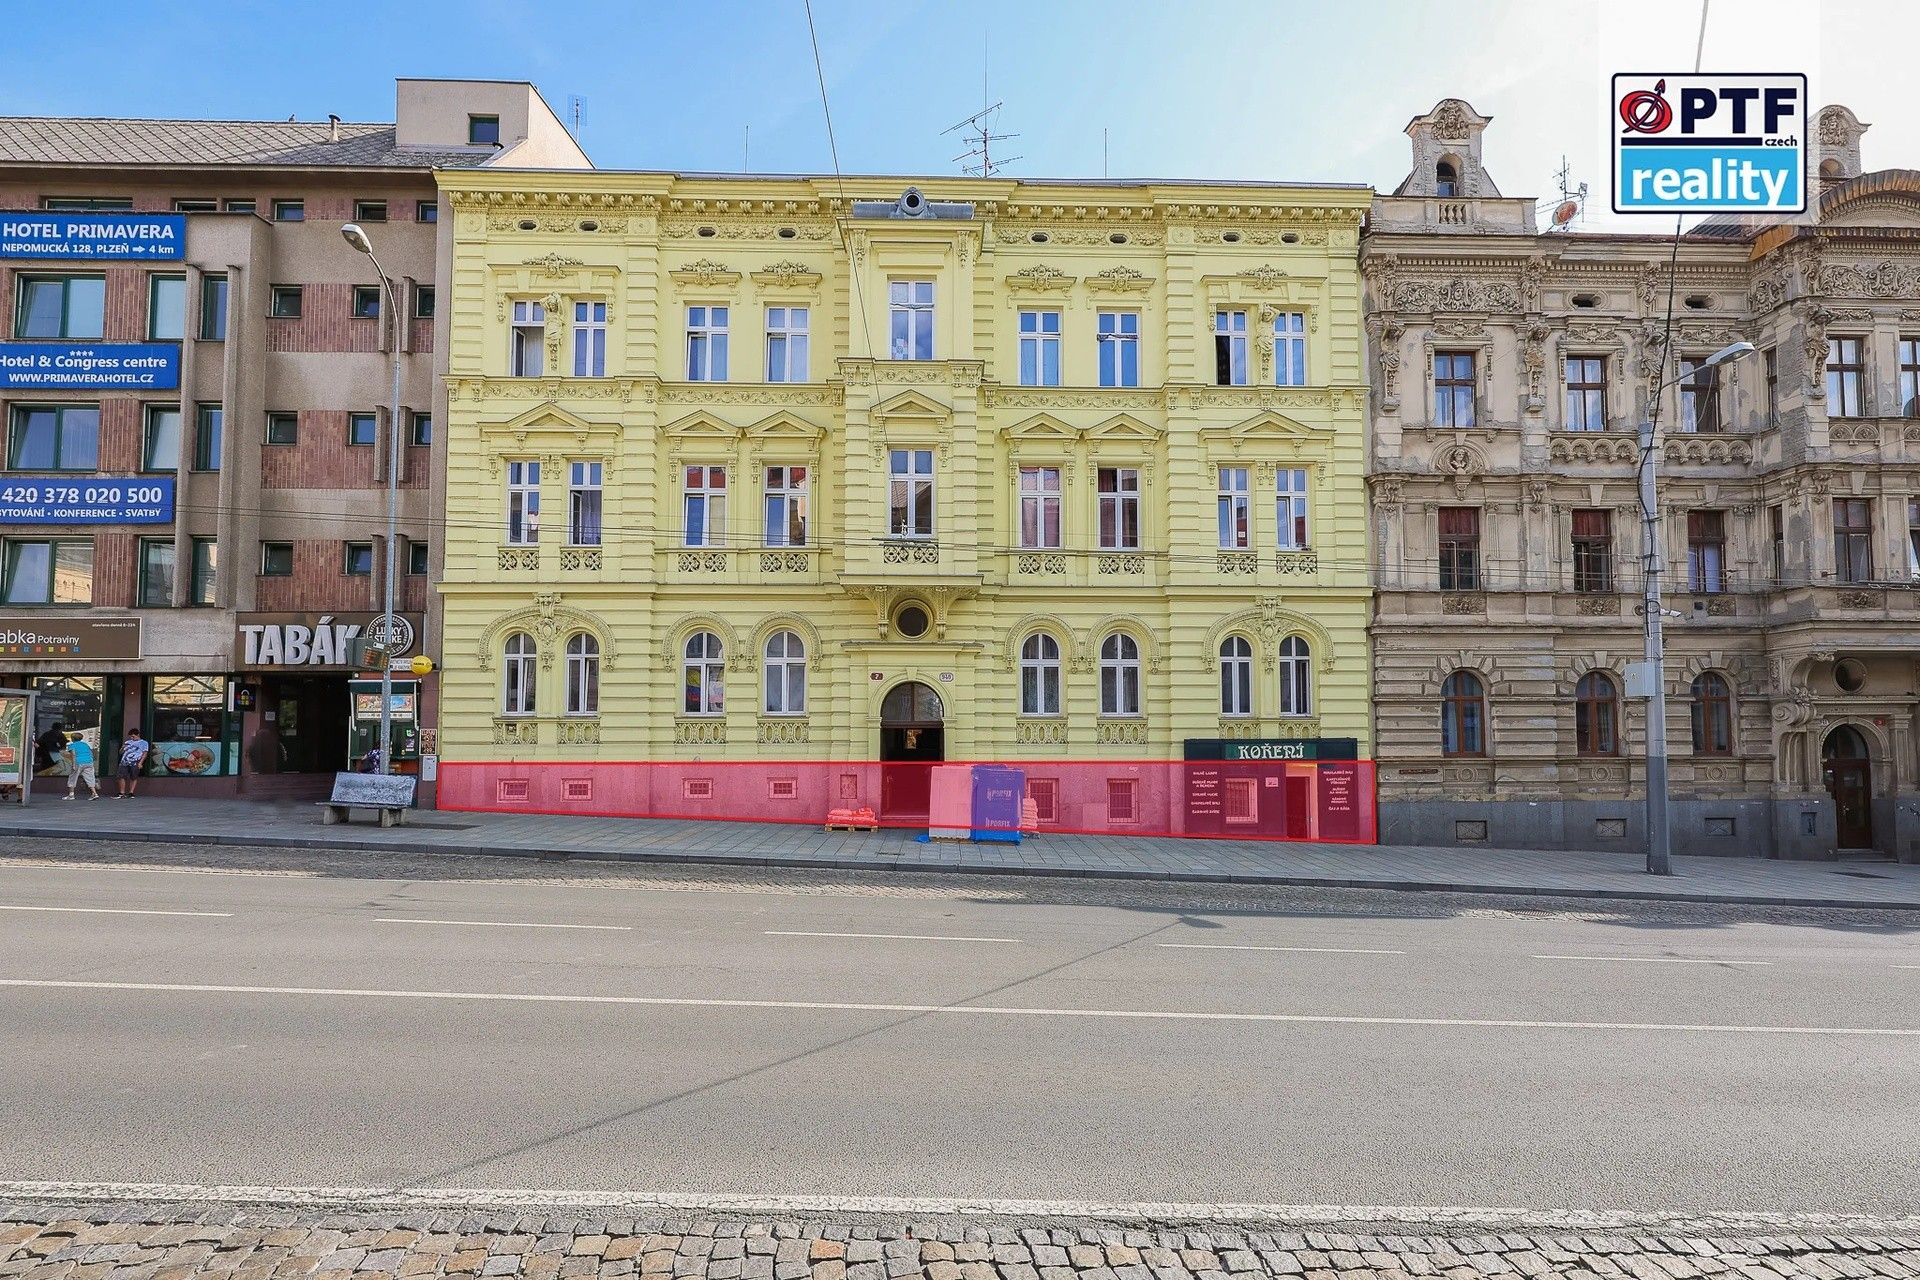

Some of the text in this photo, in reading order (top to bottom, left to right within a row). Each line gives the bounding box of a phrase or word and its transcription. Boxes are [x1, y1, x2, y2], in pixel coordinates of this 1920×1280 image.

[3, 222, 175, 239] HOTEL PRIMAVERA
[2, 242, 175, 254] NEPOMUCKÁ 128, PLZEŇ 4 km
[38, 355, 52, 367] &
[54, 355, 119, 370] Congress
[122, 356, 168, 368] centre
[8, 373, 154, 383] WWW.PRIMAVERAHOTEL.CZ
[1, 487, 163, 504] 420 378 020 500
[0, 507, 161, 518] YTOVÁNÍ KONFERENCE SVATBY
[376, 626, 402, 636] LUKY
[37, 635, 80, 646] Potraviny
[239, 615, 362, 665] TABÁK
[1237, 742, 1305, 760] KOŘENÍ
